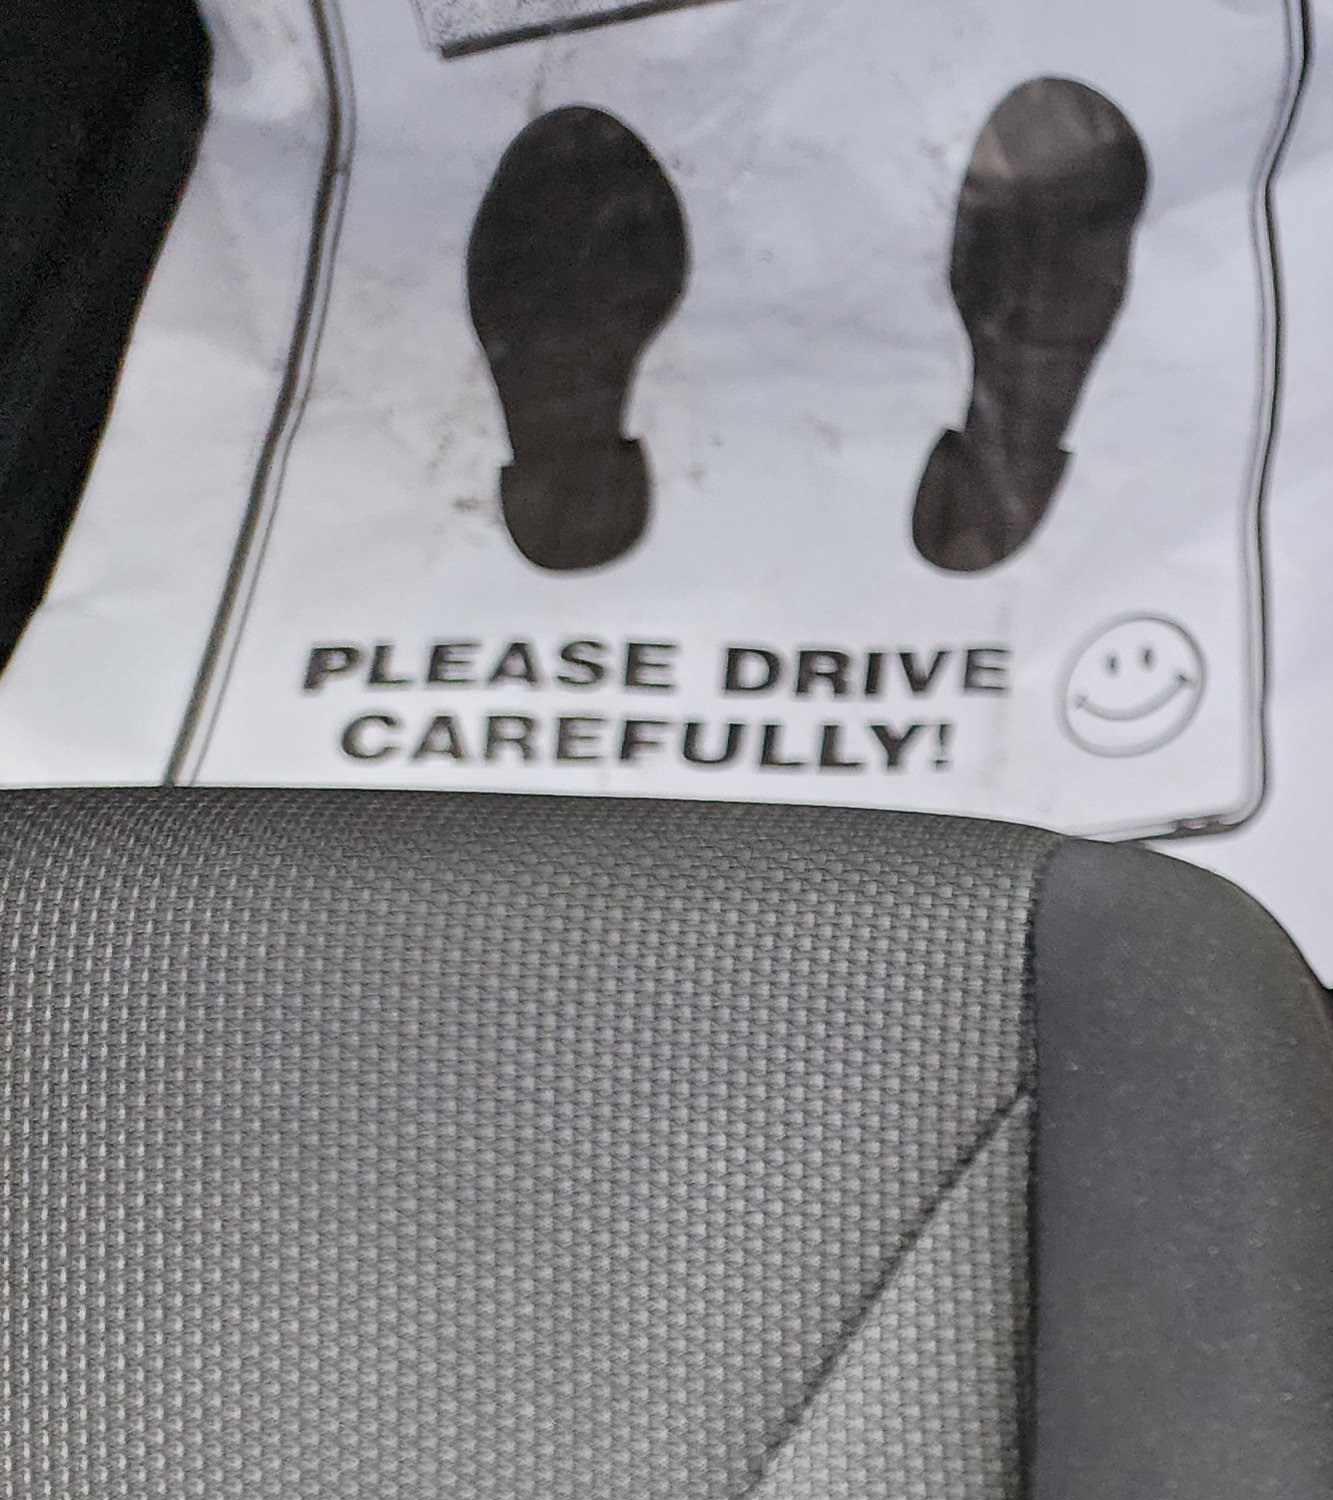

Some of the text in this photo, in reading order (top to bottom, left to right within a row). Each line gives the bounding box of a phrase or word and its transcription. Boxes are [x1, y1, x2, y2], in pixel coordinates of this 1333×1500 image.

[303, 641, 1011, 697] PLEASE DRIVE
[338, 713, 957, 772] CAREFULLY!
